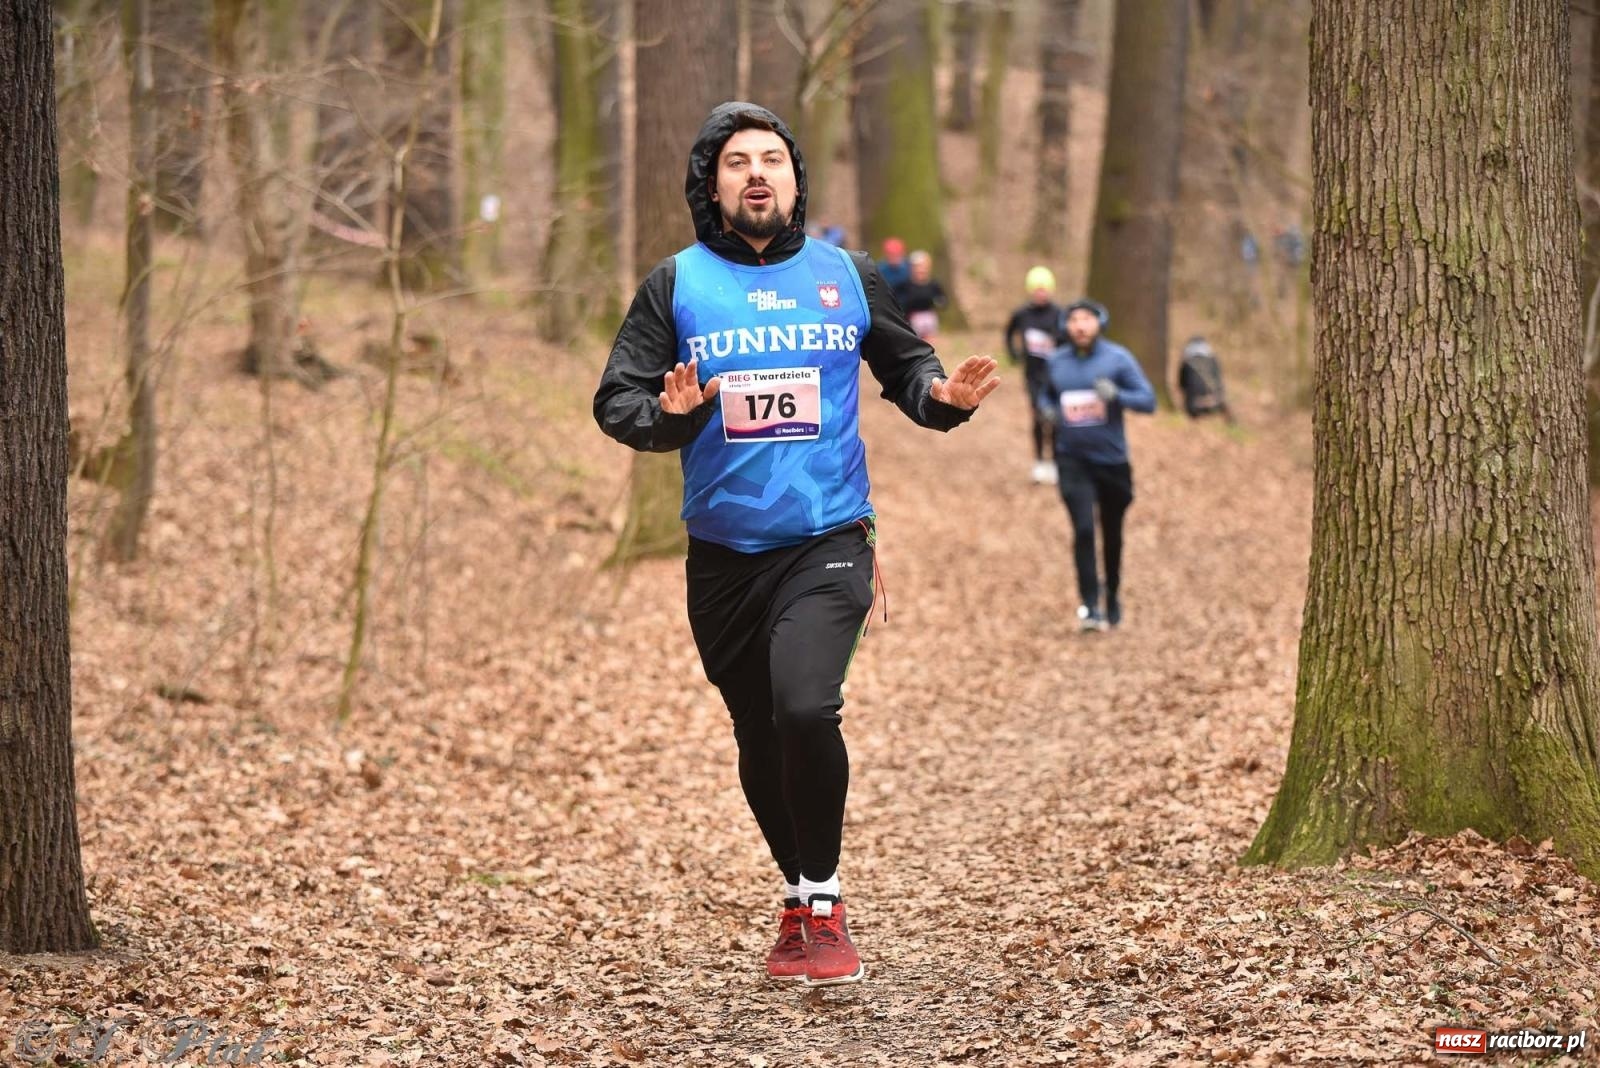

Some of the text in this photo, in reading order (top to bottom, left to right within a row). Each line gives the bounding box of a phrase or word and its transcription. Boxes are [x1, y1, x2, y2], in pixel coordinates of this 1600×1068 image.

[687, 323, 858, 361] RUNNERS
[728, 370, 811, 382] BIEG Twardziela
[745, 393, 796, 420] 176
